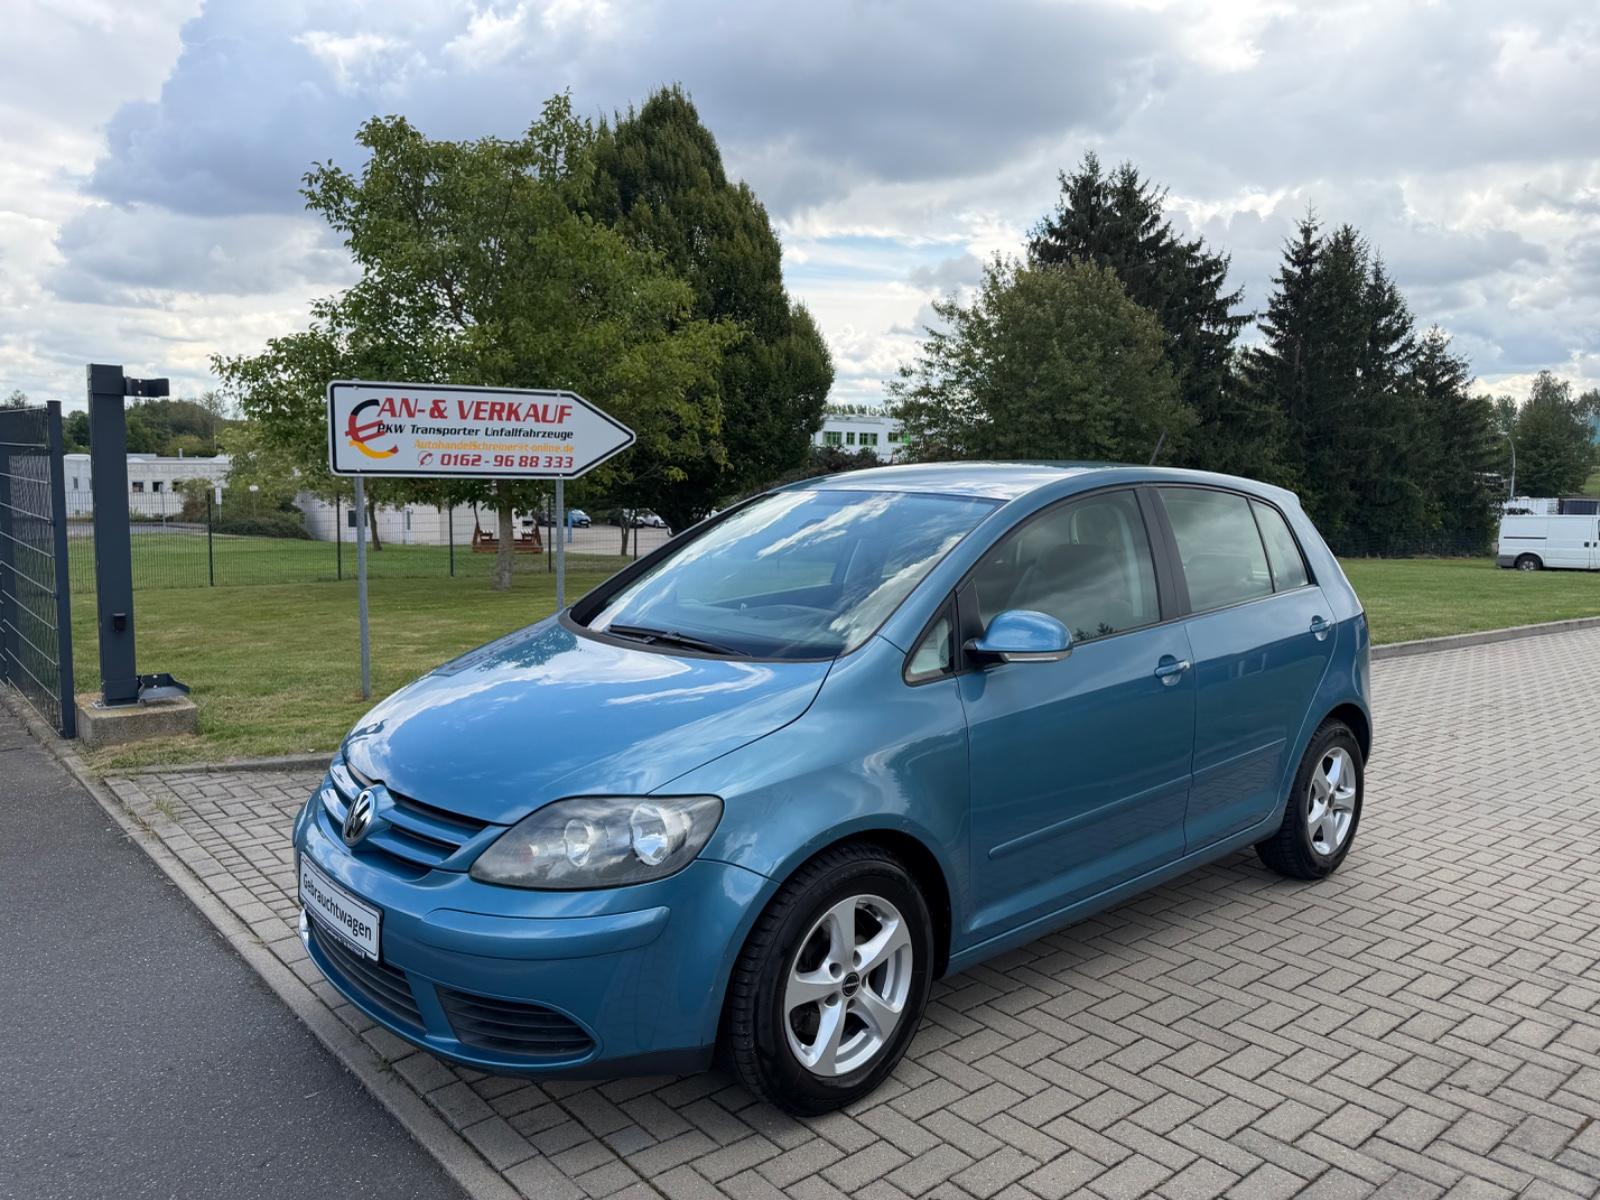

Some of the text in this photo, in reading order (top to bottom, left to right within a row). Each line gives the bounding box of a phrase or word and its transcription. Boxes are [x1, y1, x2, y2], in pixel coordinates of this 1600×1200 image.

[457, 400, 573, 424] VERKAUF
[377, 423, 574, 441] PKW Transporter Unfallfahrzeuge
[440, 453, 482, 467] 0162
[493, 454, 515, 467] 96
[518, 455, 540, 468] 88
[543, 455, 573, 468] 333
[303, 872, 372, 941] Gebrauchtwagen
